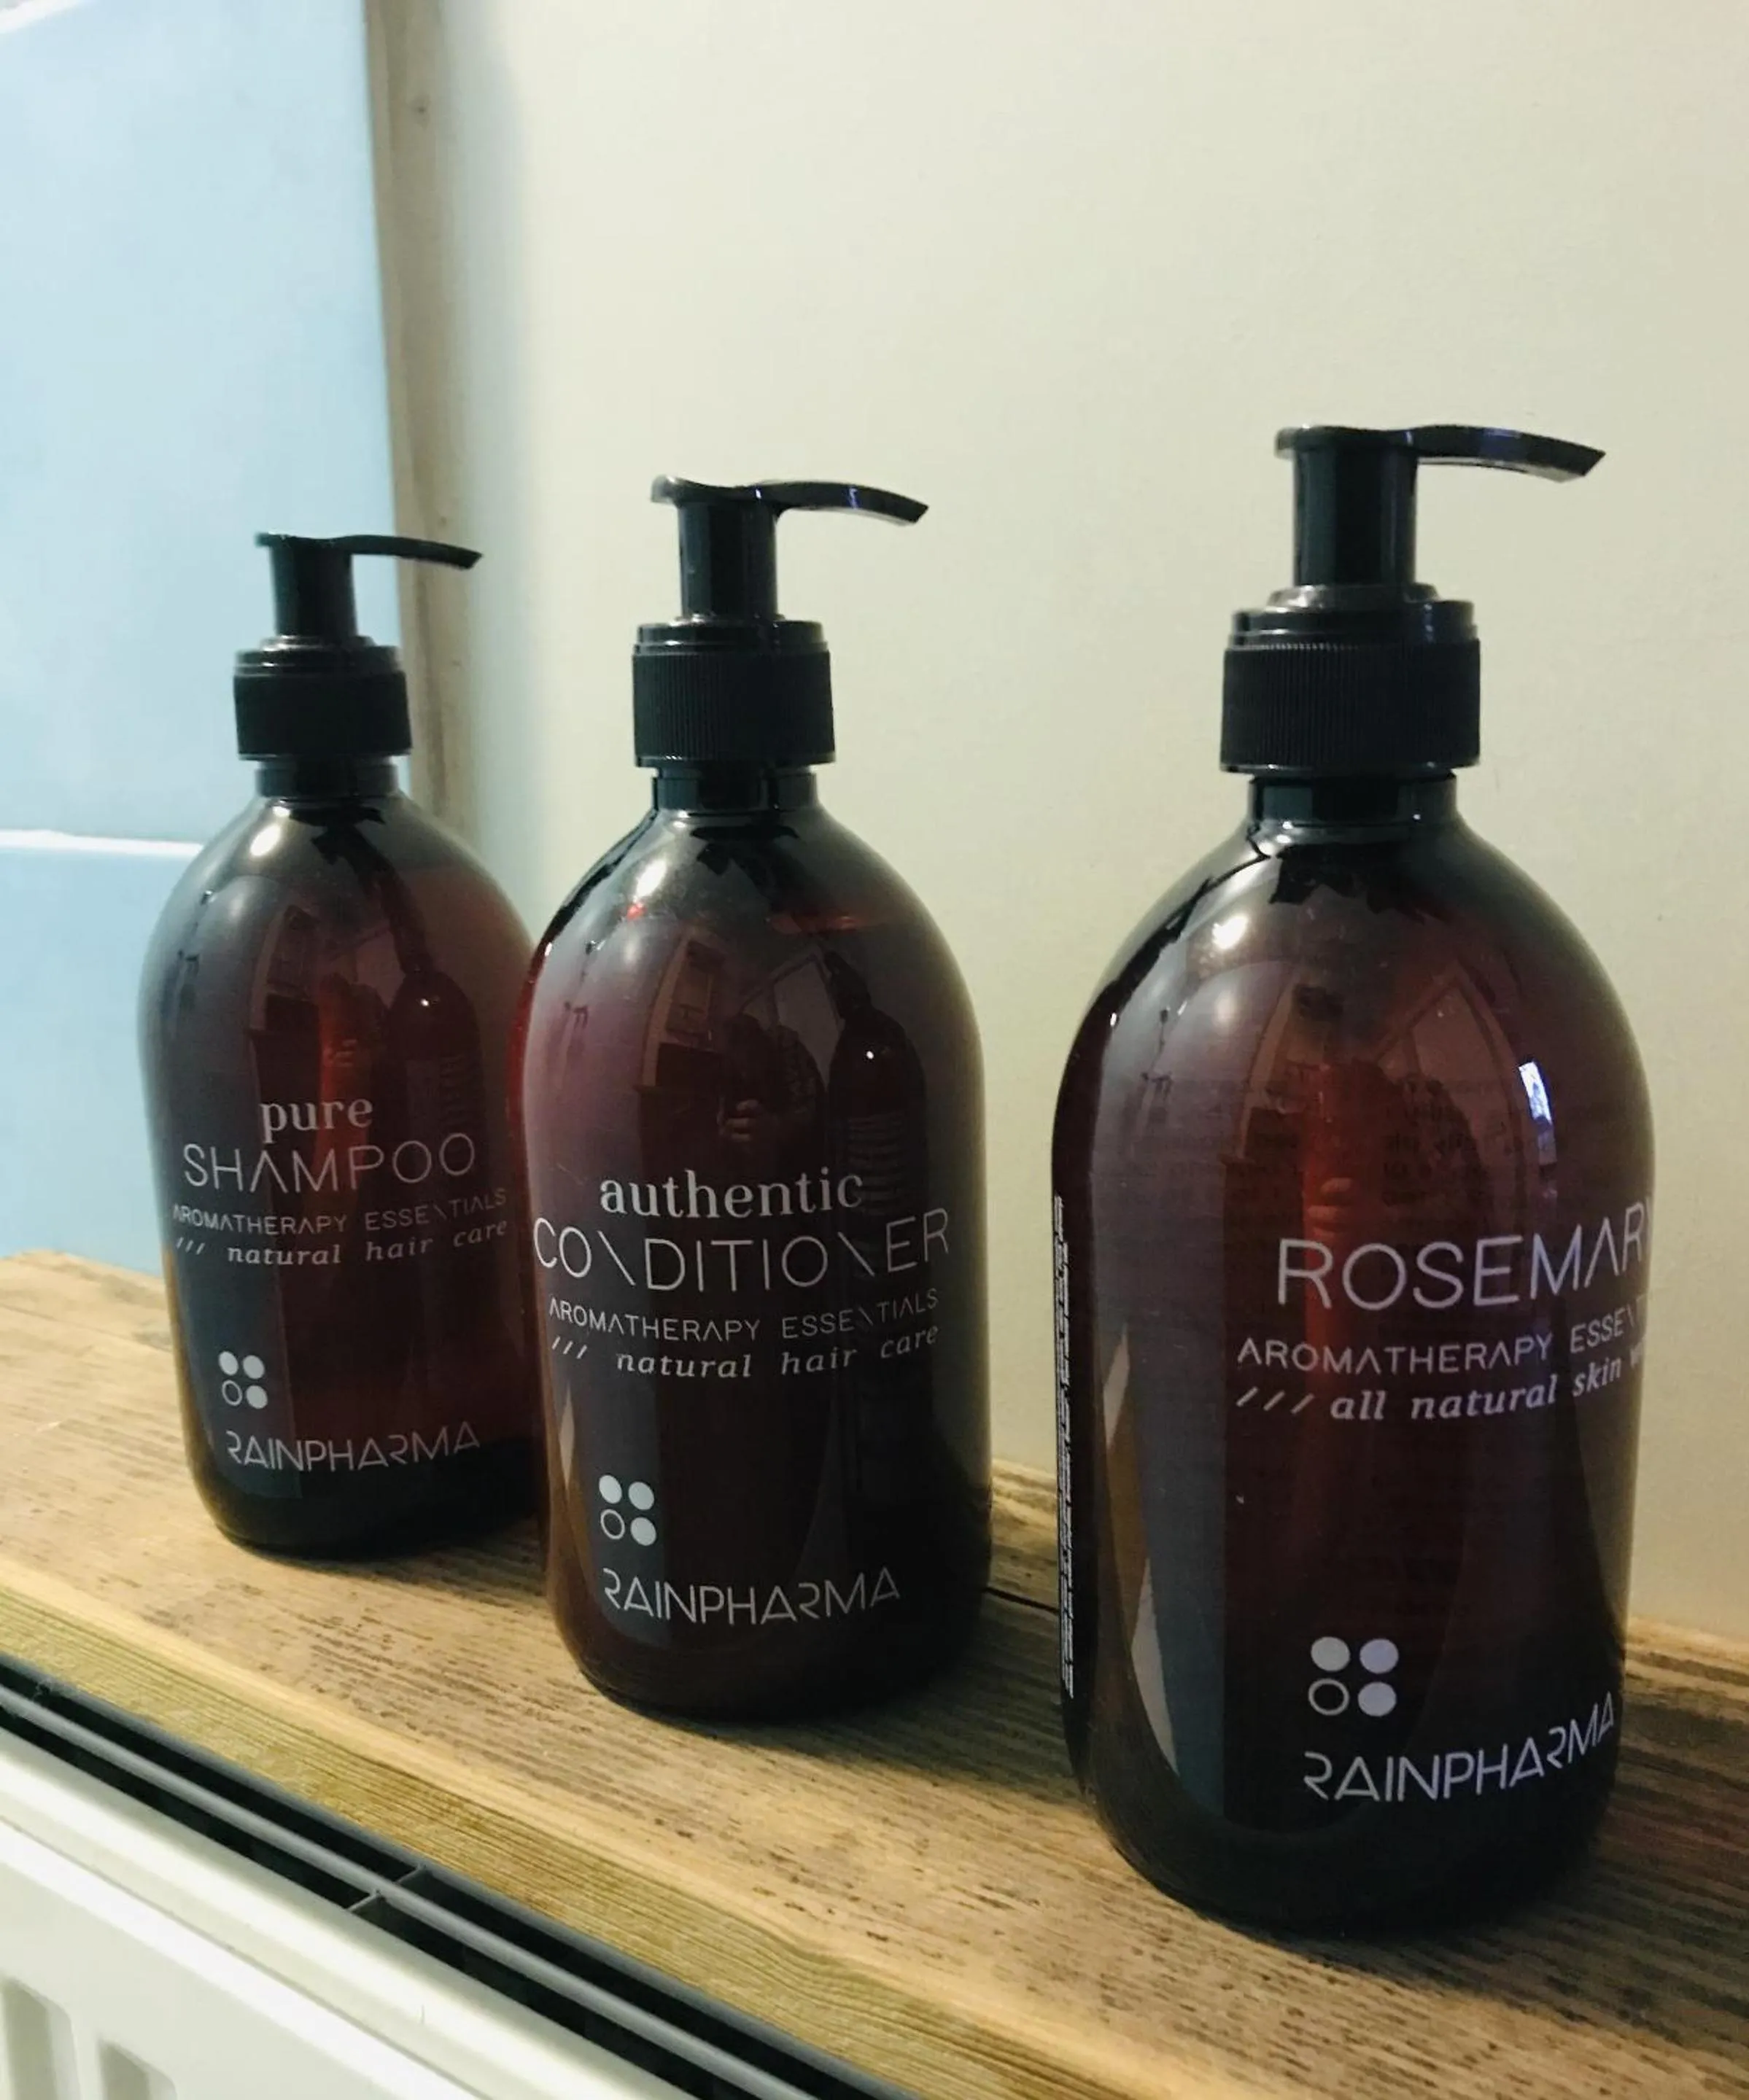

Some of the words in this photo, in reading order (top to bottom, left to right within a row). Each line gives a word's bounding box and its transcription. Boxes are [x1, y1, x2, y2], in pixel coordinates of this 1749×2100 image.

[260, 1098, 373, 1143] pure
[183, 1132, 476, 1194] SHAMPOO
[599, 1166, 864, 1218] authentic
[172, 1203, 348, 1236] AROMATHERAPY
[227, 1243, 341, 1265] natural
[365, 1237, 434, 1262] hair
[452, 1220, 508, 1248] care
[1277, 1196, 1653, 1311] ROSEMAR
[548, 1295, 761, 1342] AROMATHERAPY
[616, 1353, 753, 1379] natural
[780, 1345, 858, 1376] hair
[880, 1324, 940, 1360] care
[1237, 1333, 1554, 1375] AROMATHERAPY
[1330, 1390, 1386, 1420] all
[1411, 1374, 1557, 1420] natural
[1571, 1356, 1621, 1398] skin
[225, 1421, 481, 1471] RAINPHARMA
[602, 1566, 901, 1625] RAINPHARMA
[1303, 1690, 1616, 1802] RAINPHARMA
